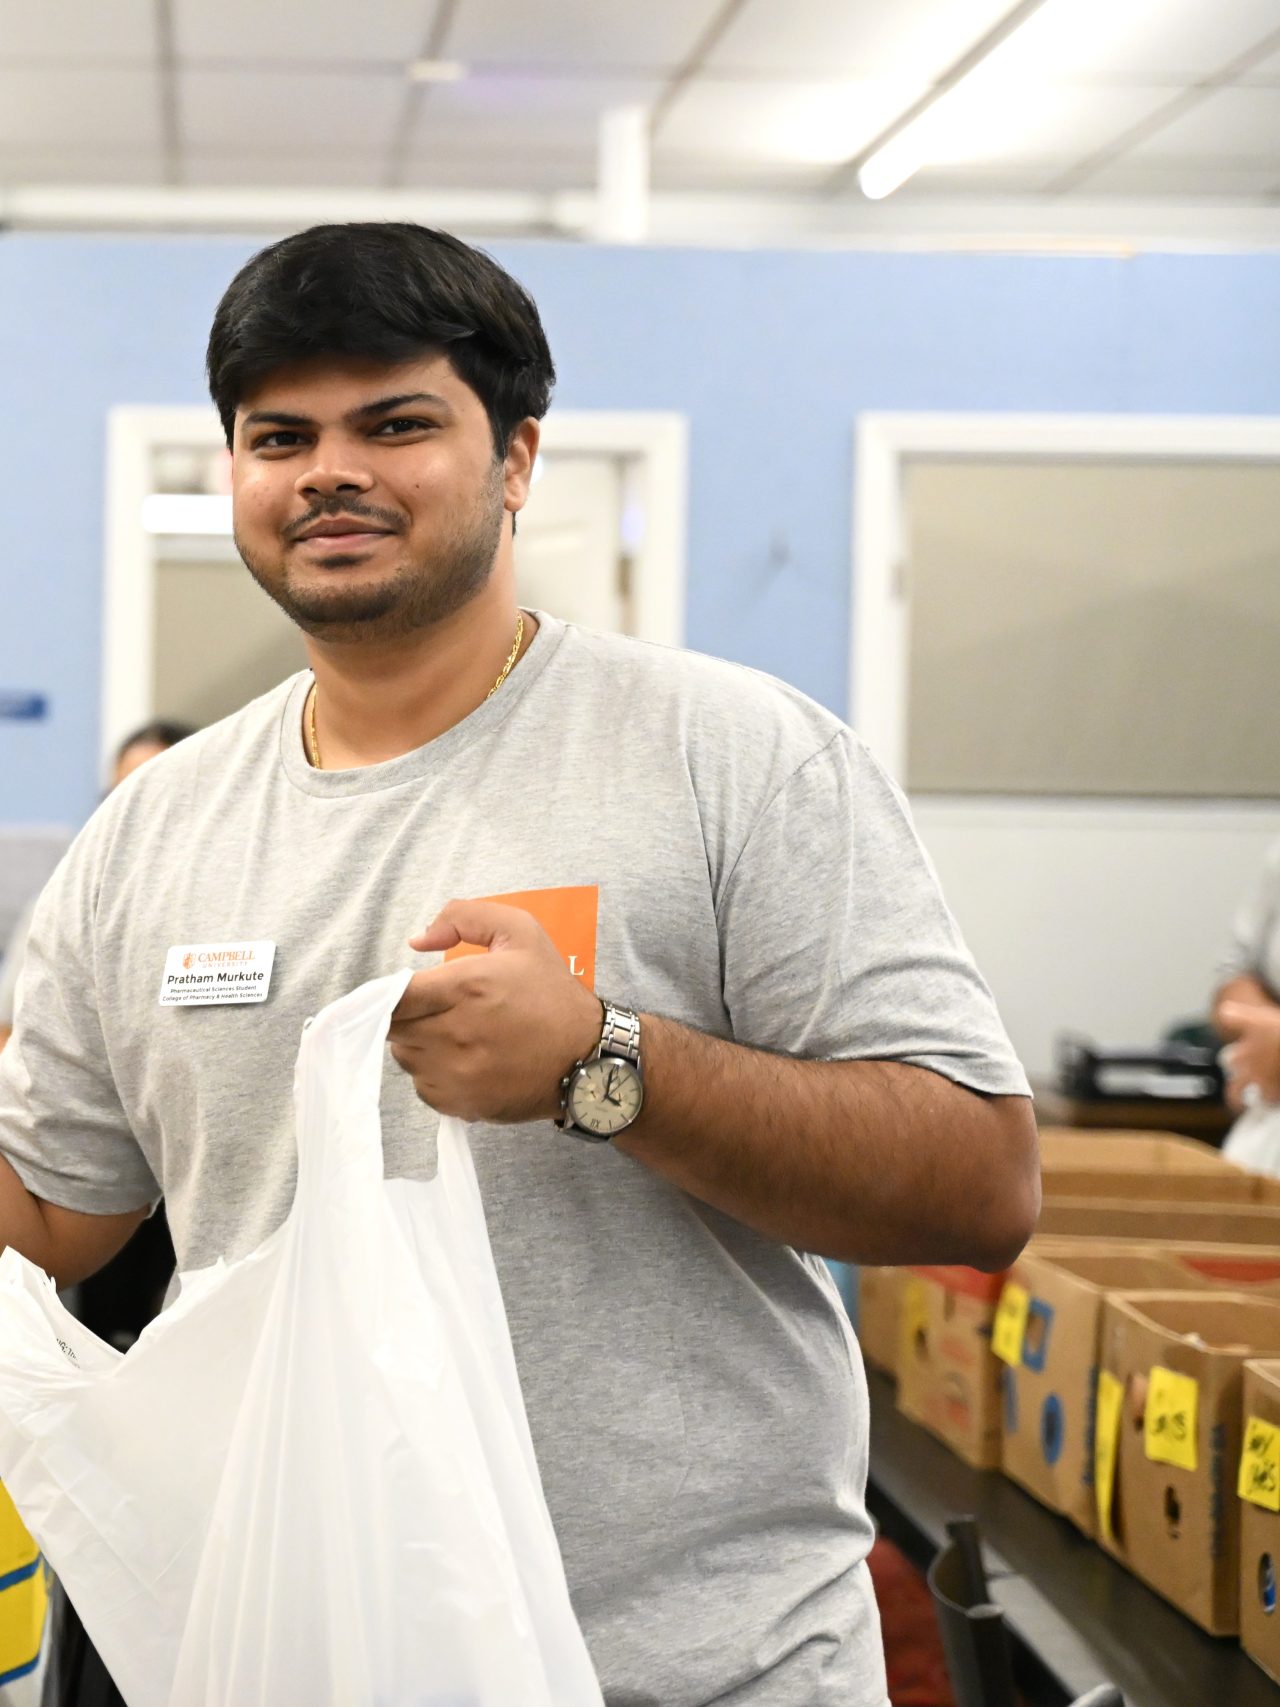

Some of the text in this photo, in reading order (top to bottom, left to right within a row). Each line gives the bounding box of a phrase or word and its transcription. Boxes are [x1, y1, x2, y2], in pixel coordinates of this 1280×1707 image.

[198, 951, 255, 962] CAMPBELL
[167, 971, 264, 985] Pratham Murkute
